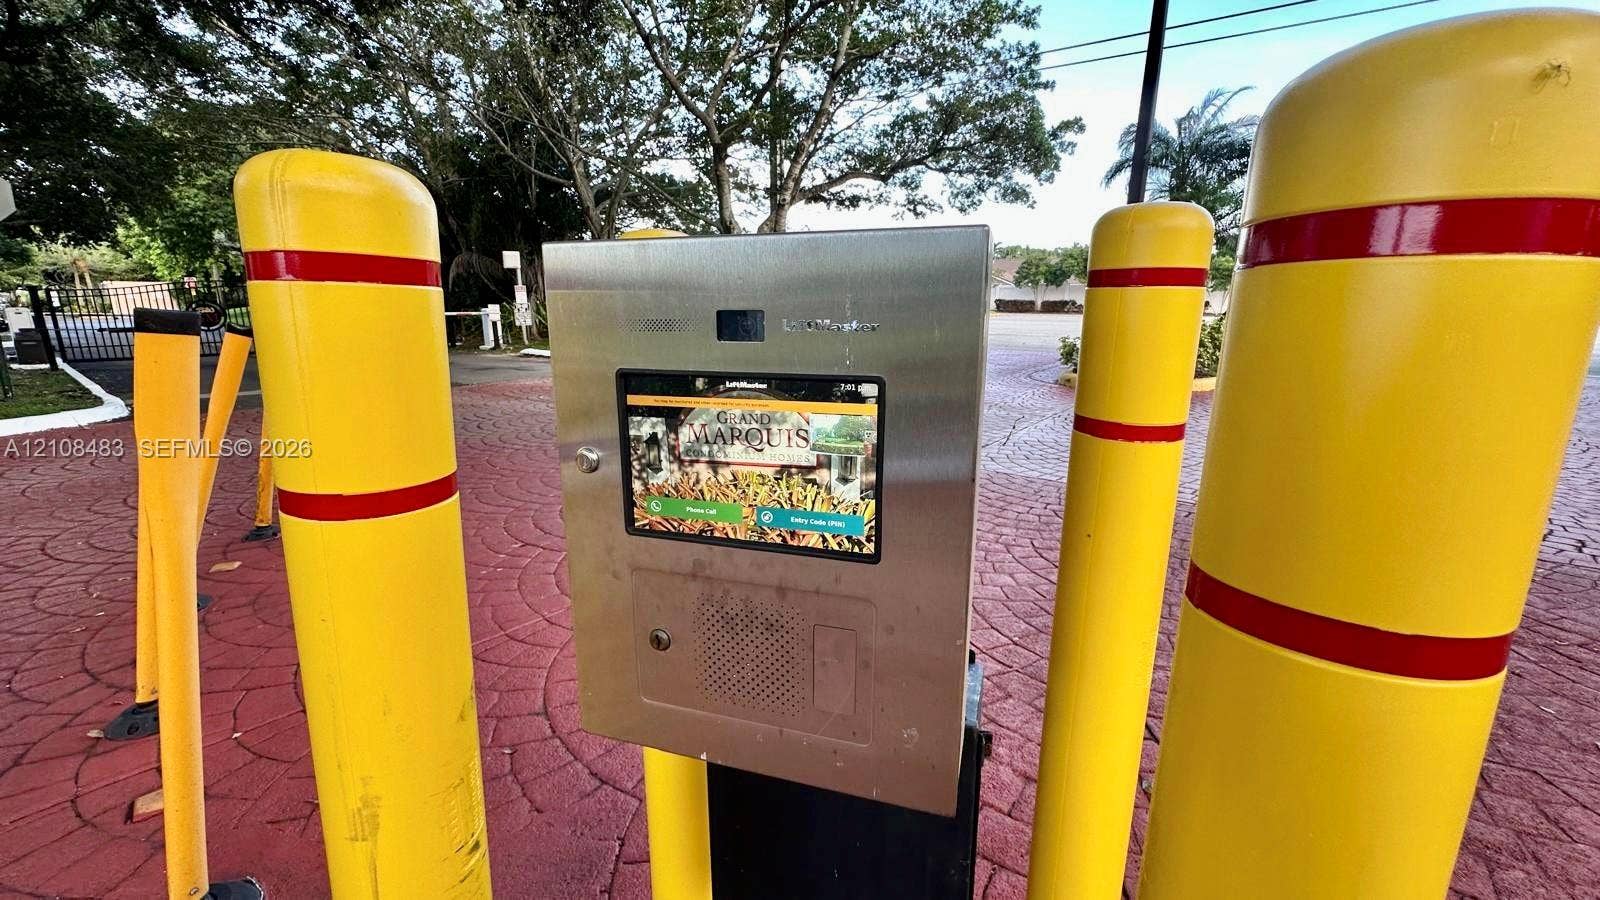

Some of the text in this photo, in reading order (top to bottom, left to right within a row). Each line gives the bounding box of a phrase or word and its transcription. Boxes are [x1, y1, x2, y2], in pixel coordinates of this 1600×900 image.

[840, 383, 856, 391] 7:01
[716, 410, 771, 425] GRAND
[686, 423, 810, 452] MARQUIS
[770, 453, 811, 463] HOMES
[686, 506, 704, 514] Phone
[790, 516, 846, 528] Entry Code (PIN)
